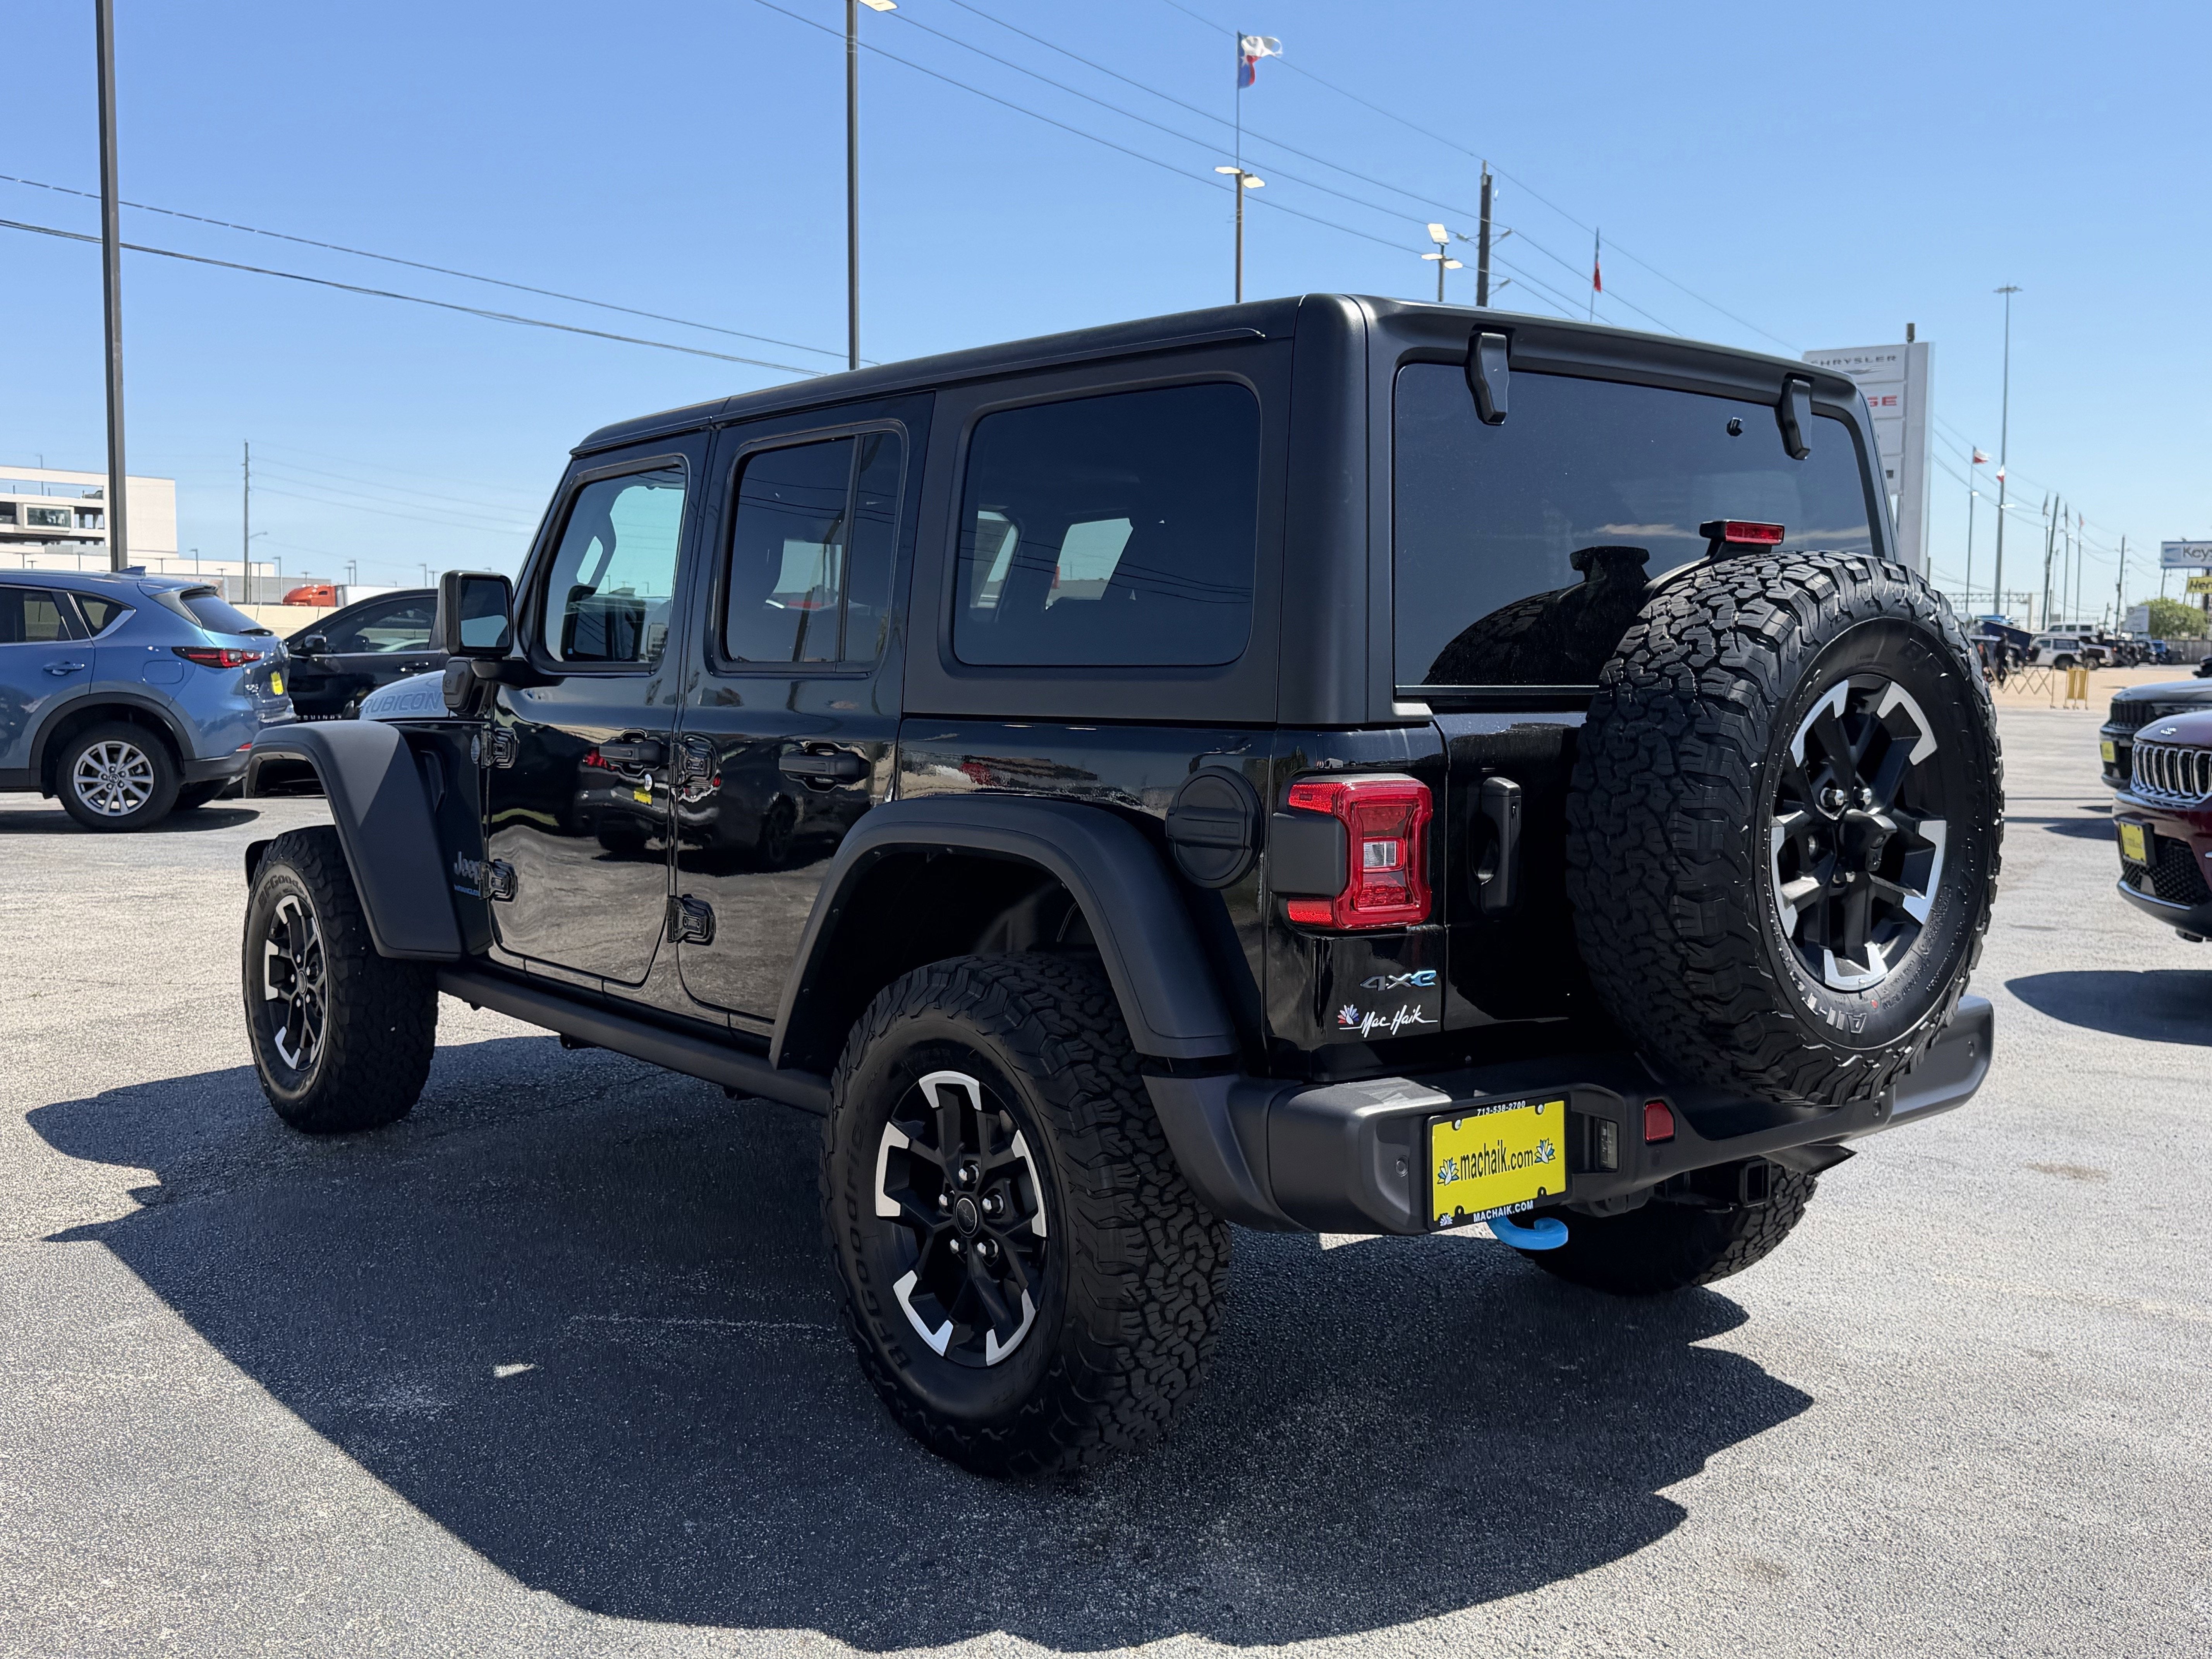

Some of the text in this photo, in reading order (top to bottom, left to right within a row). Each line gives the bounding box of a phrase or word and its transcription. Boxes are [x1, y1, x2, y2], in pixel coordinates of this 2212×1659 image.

[1810, 355, 1896, 366] CHRYSLER
[362, 692, 443, 714] RUBICON
[1359, 1005, 1438, 1038] Mac Haik
[1477, 1100, 1526, 1116] 713-538-2700
[1460, 1139, 1534, 1181] machaik.com
[1473, 1200, 1534, 1223] MACHAIK.COM
